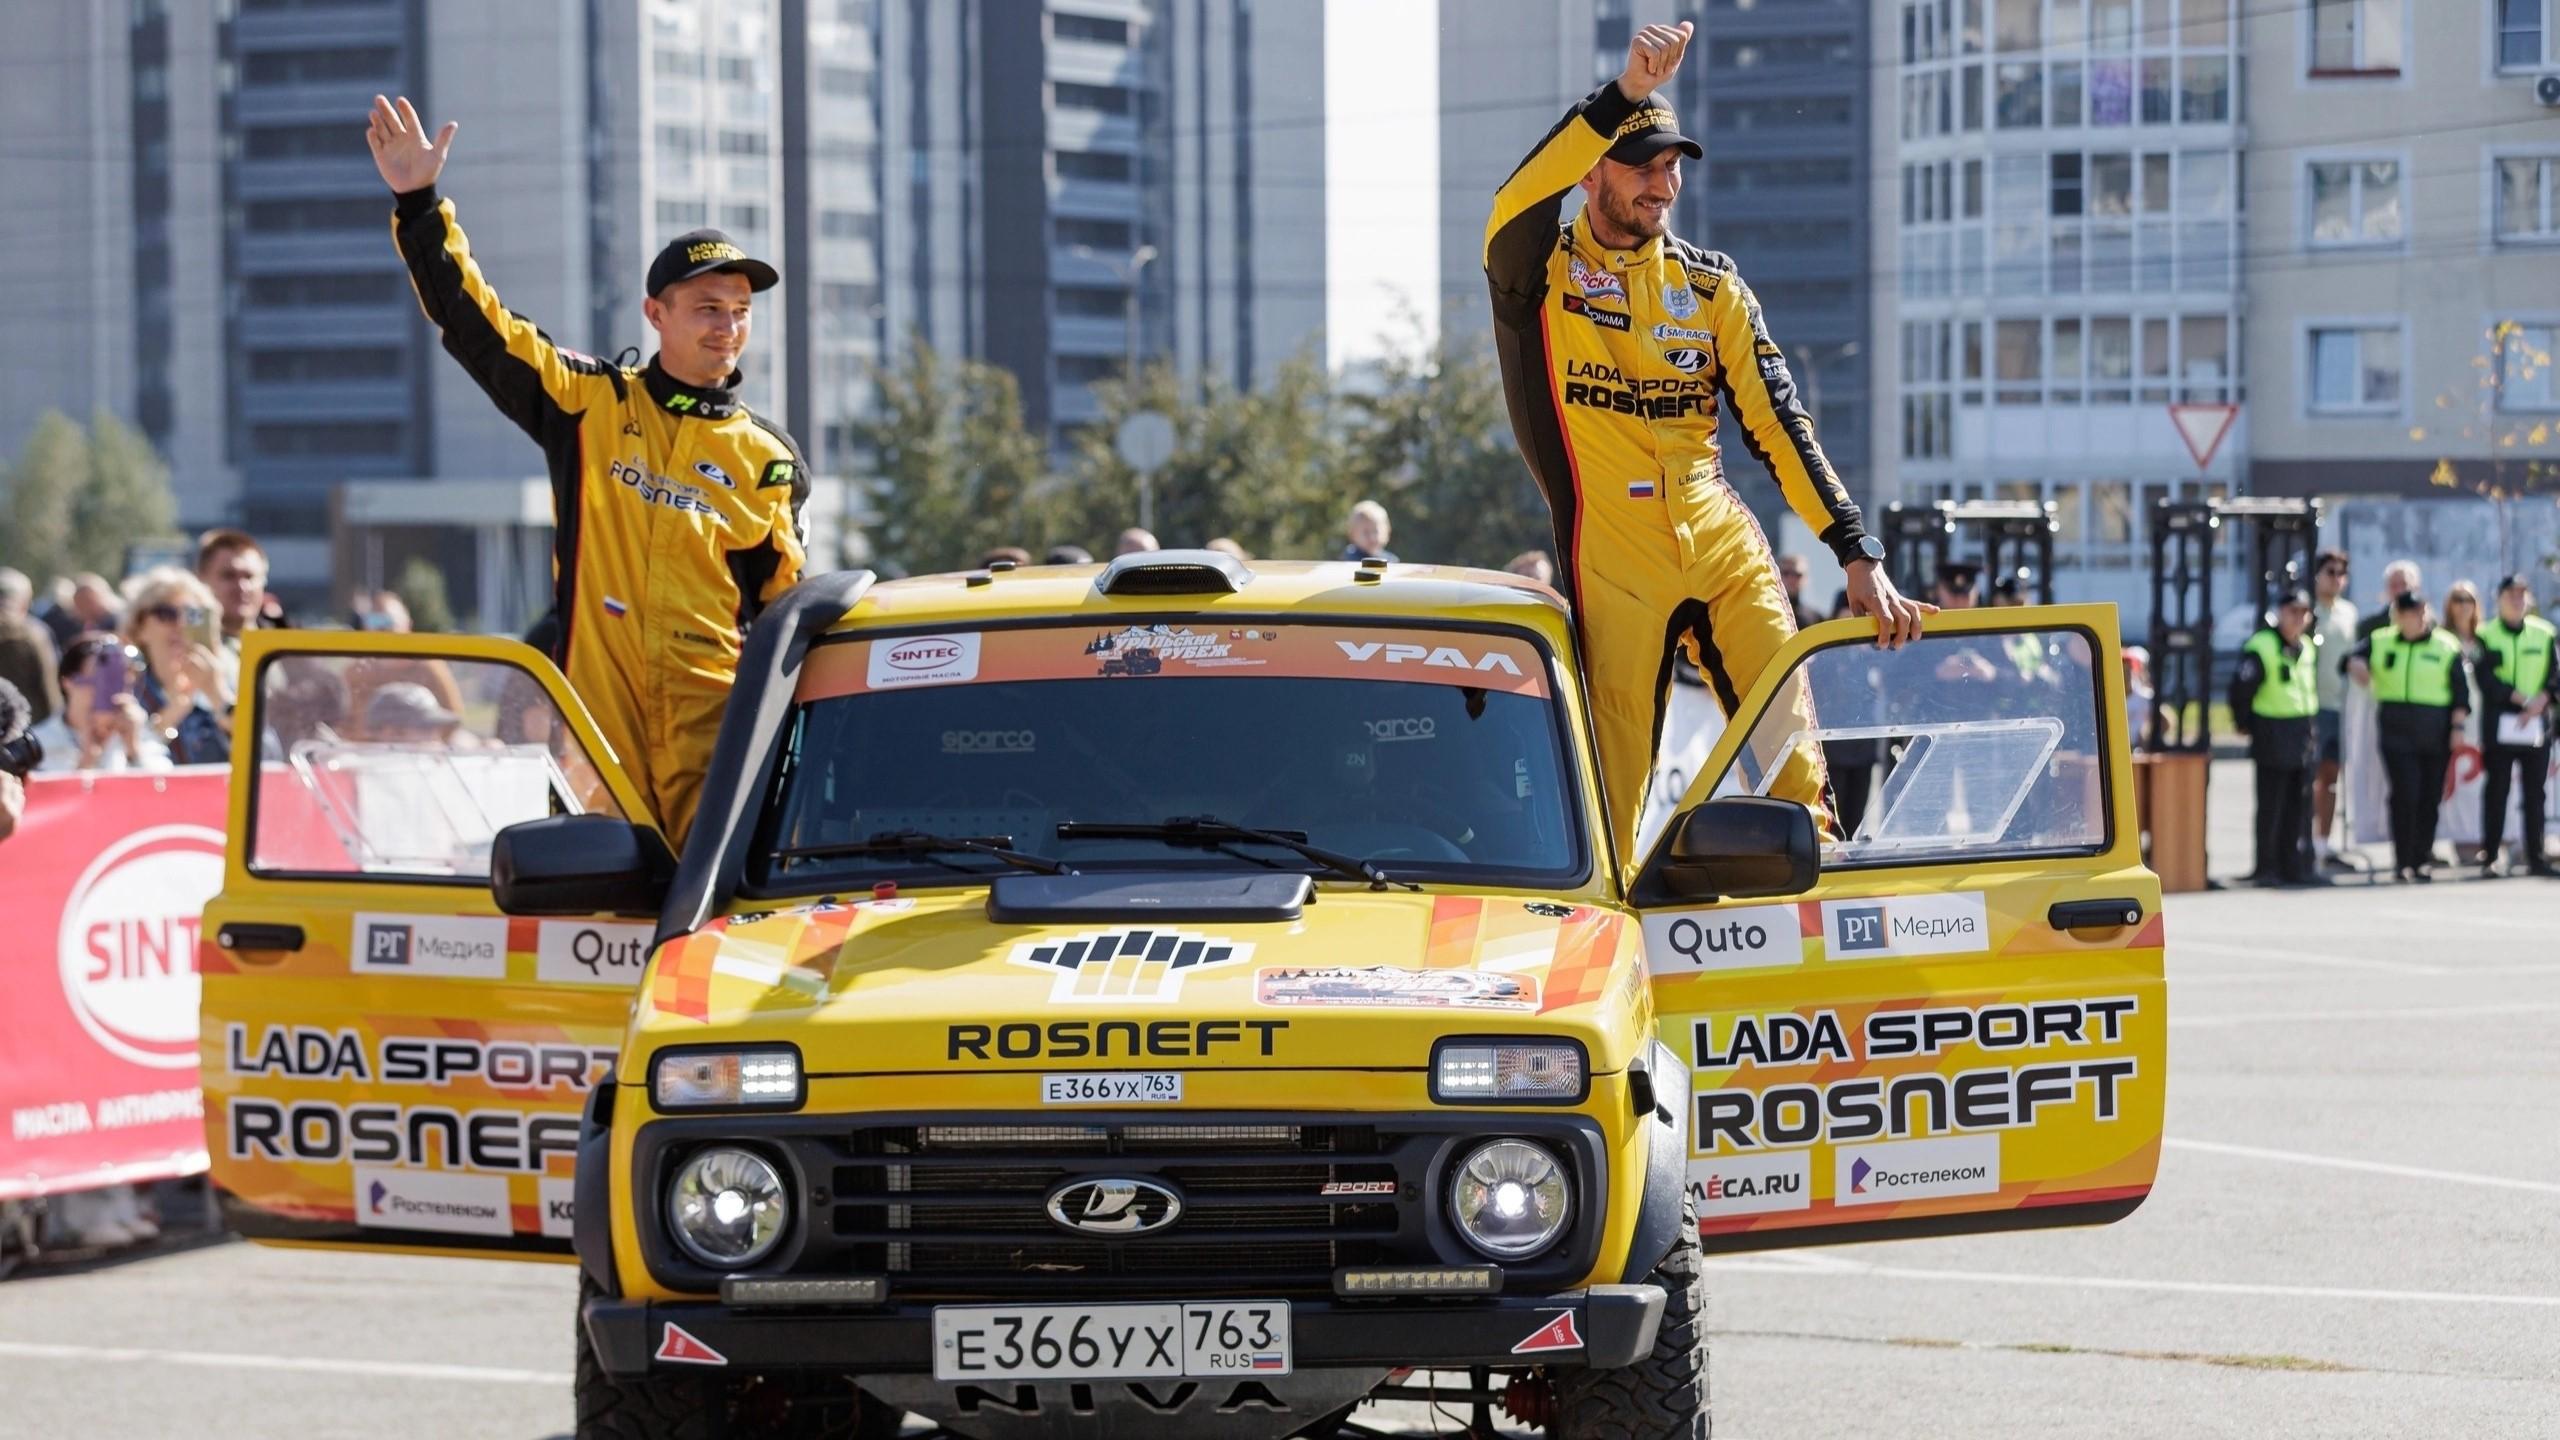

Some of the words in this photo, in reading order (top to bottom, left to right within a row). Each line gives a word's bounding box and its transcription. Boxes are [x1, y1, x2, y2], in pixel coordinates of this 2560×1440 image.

[1688, 272, 1719, 290] OMP
[1686, 330, 1713, 342] RACIN
[1567, 359, 1622, 385] LADA
[1566, 382, 1710, 420] ROSNEFT
[890, 647, 960, 662] SINTEC
[1113, 633, 1218, 650] УРАЛЬСКИЙ
[1158, 644, 1232, 660] РУБЕЖ
[1335, 641, 1522, 676] УРАЛ
[942, 729, 1036, 752] sparco
[1668, 918, 1767, 964] Quto
[1844, 915, 1878, 943] РГ
[1893, 915, 1975, 939] Медиа
[87, 916, 202, 981] SINT
[372, 930, 406, 958] РГ
[417, 937, 495, 961] Медиа
[948, 1020, 1290, 1060] ROSNEFT
[1695, 1014, 1848, 1068] LADA
[1867, 999, 2135, 1056] SPORT
[232, 1028, 367, 1078] LADA
[1144, 1075, 1175, 1093] 763
[1698, 1060, 2134, 1149] ROSNEFT
[234, 1104, 582, 1170] ROSNEF
[1321, 1182, 1395, 1195] SPORT
[1875, 1166, 1986, 1188] Ростелеком
[392, 1196, 497, 1219] Ростелеком
[1188, 1309, 1272, 1351] 763
[1210, 1353, 1251, 1368] RUS
[954, 1381, 1292, 1415] NIVA
